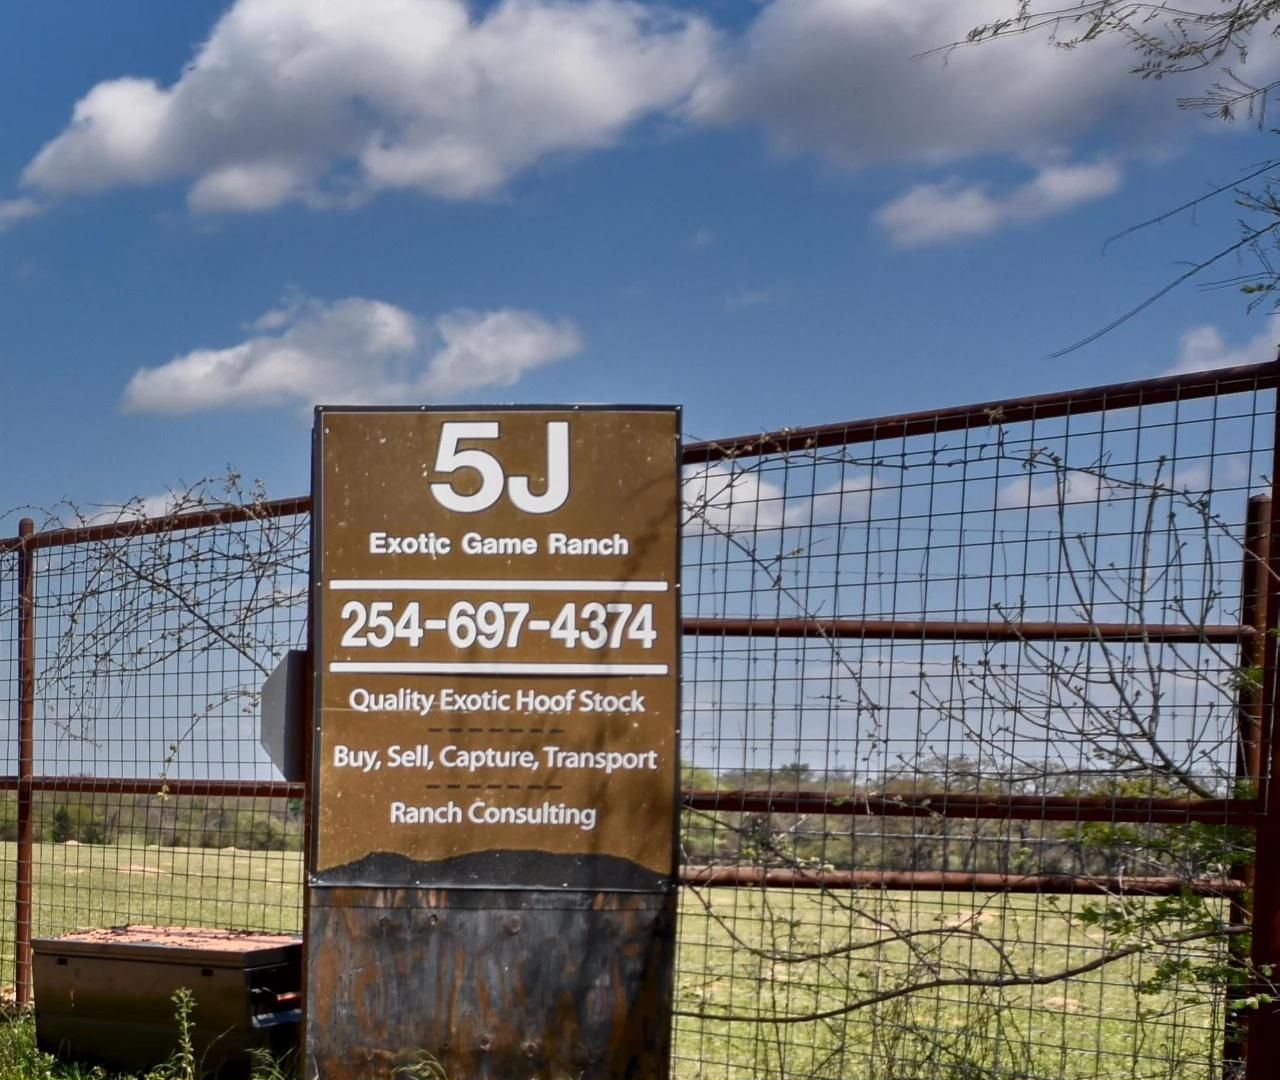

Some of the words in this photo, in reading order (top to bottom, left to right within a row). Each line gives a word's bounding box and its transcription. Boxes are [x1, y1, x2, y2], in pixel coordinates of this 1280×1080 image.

[430, 421, 570, 514] 5J
[369, 532, 451, 556] Exotic
[461, 532, 538, 556] Game
[548, 532, 629, 556] Ranch
[340, 600, 657, 649] 254-697-4374
[348, 688, 435, 715] Quality
[439, 689, 511, 712] Exotic
[516, 689, 576, 712] Hoof
[579, 689, 645, 713] Stock
[333, 745, 381, 771] Buy,
[387, 745, 434, 771] Sell,
[439, 746, 539, 772] Capture,
[542, 746, 658, 773] Transport
[390, 801, 462, 824] Ranch
[468, 801, 597, 830] Consulting
